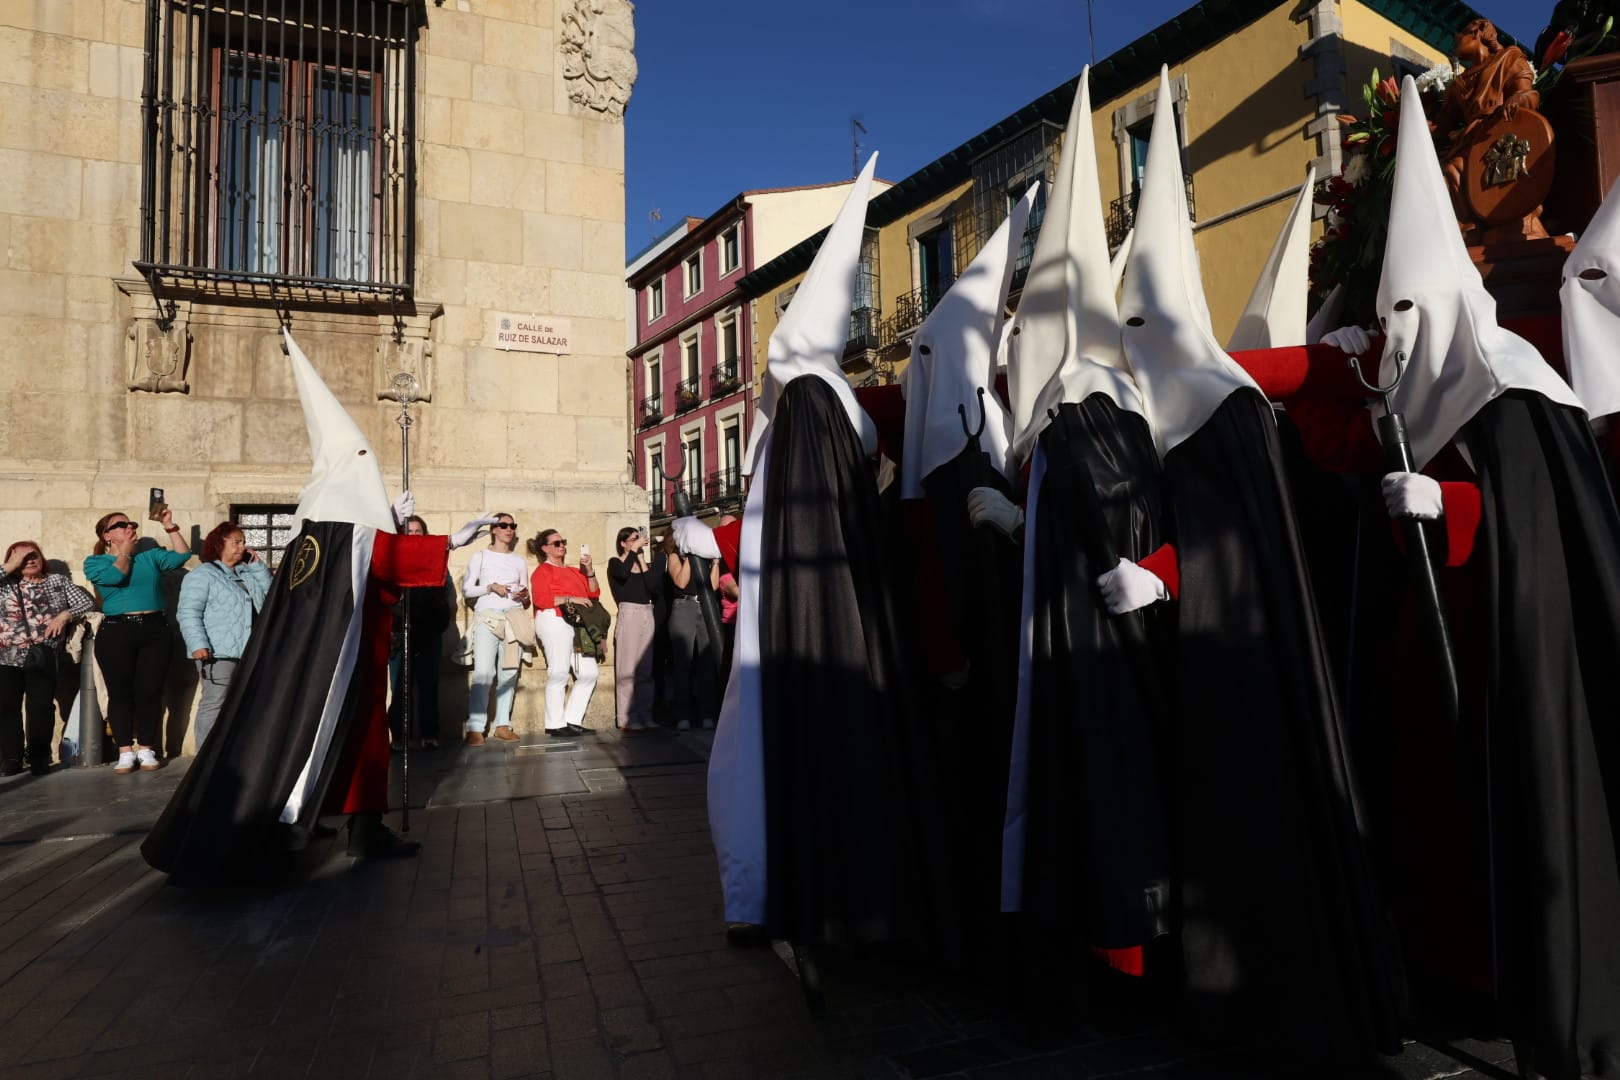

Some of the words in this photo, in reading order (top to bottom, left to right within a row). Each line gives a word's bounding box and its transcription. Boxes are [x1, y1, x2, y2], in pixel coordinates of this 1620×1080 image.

[517, 323, 543, 332] CALLE
[498, 332, 517, 342] RUIZ
[518, 334, 530, 343] DE
[531, 335, 568, 347] SALAZAR
